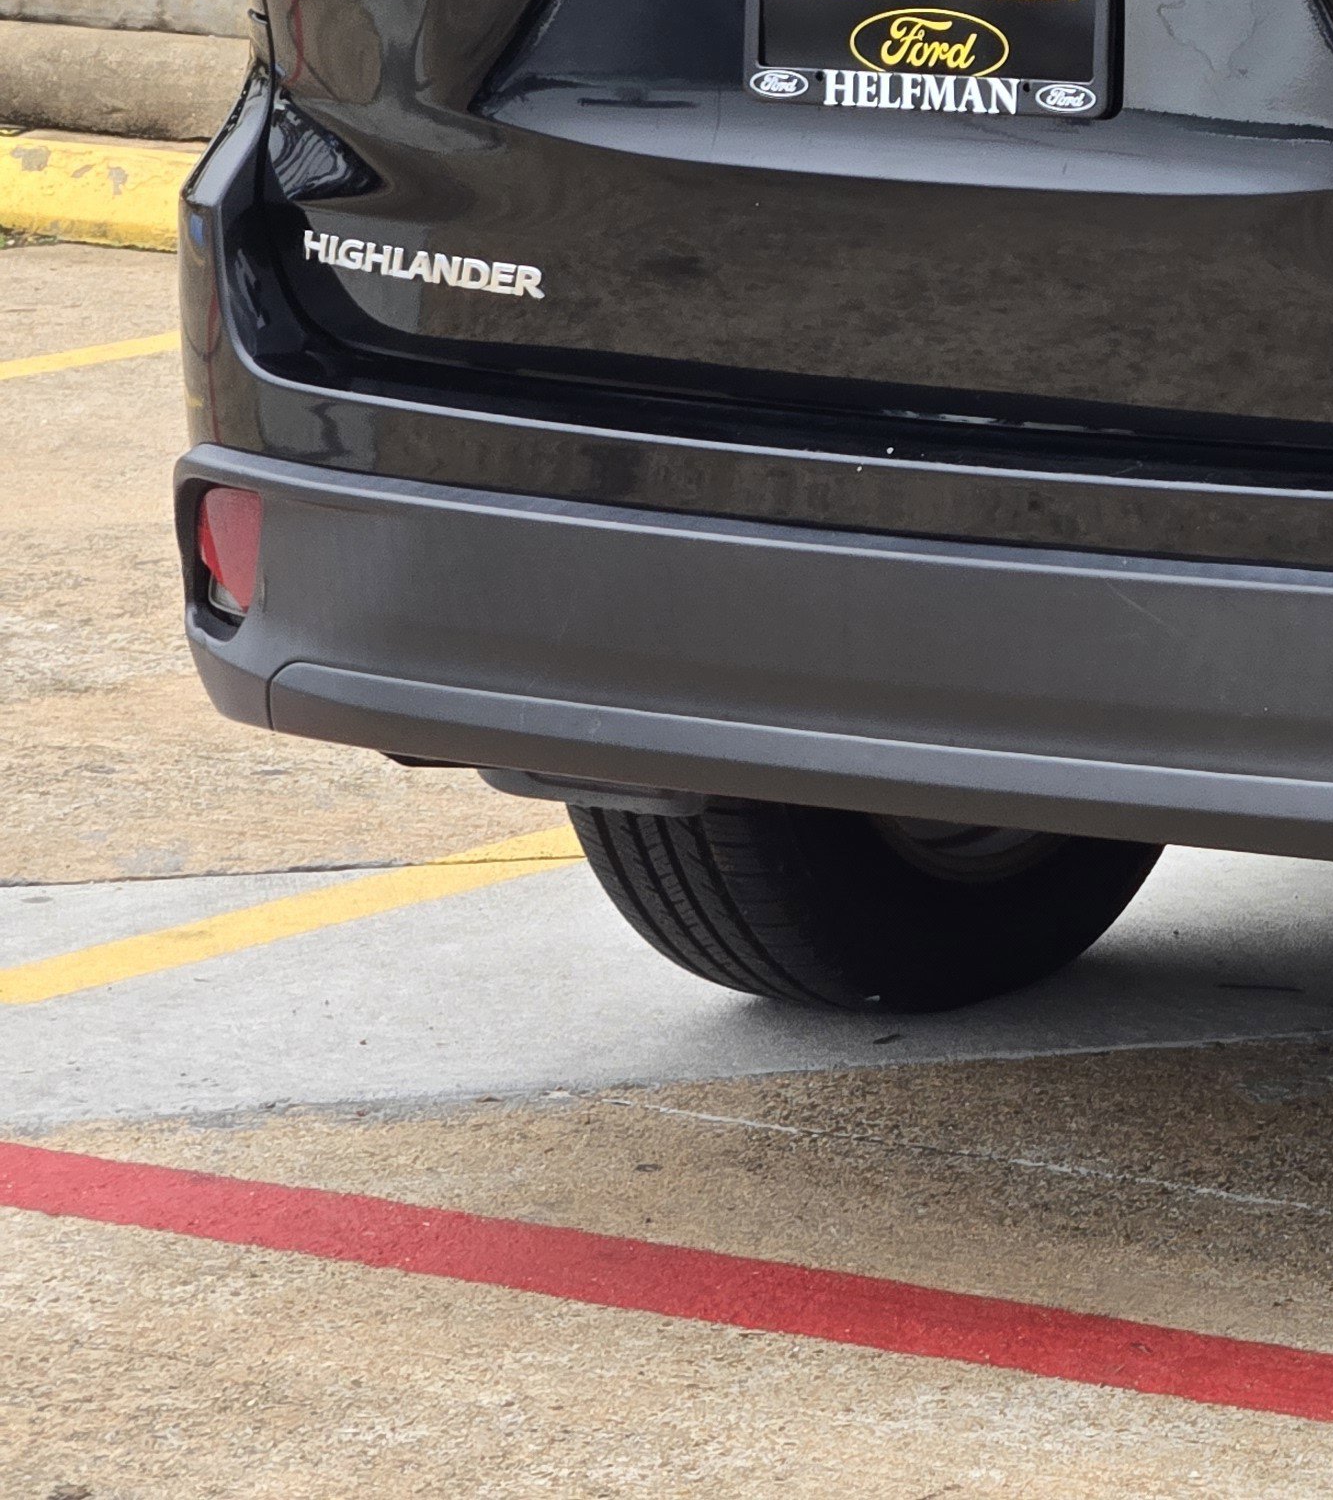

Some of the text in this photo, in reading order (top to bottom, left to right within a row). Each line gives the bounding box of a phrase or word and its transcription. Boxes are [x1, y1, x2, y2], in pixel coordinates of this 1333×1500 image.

[880, 16, 979, 69] Ford
[759, 74, 797, 92] Ford
[823, 68, 1021, 115] HELFMAN
[1045, 88, 1085, 108] Ford
[303, 229, 546, 301] HIGHLANDER
